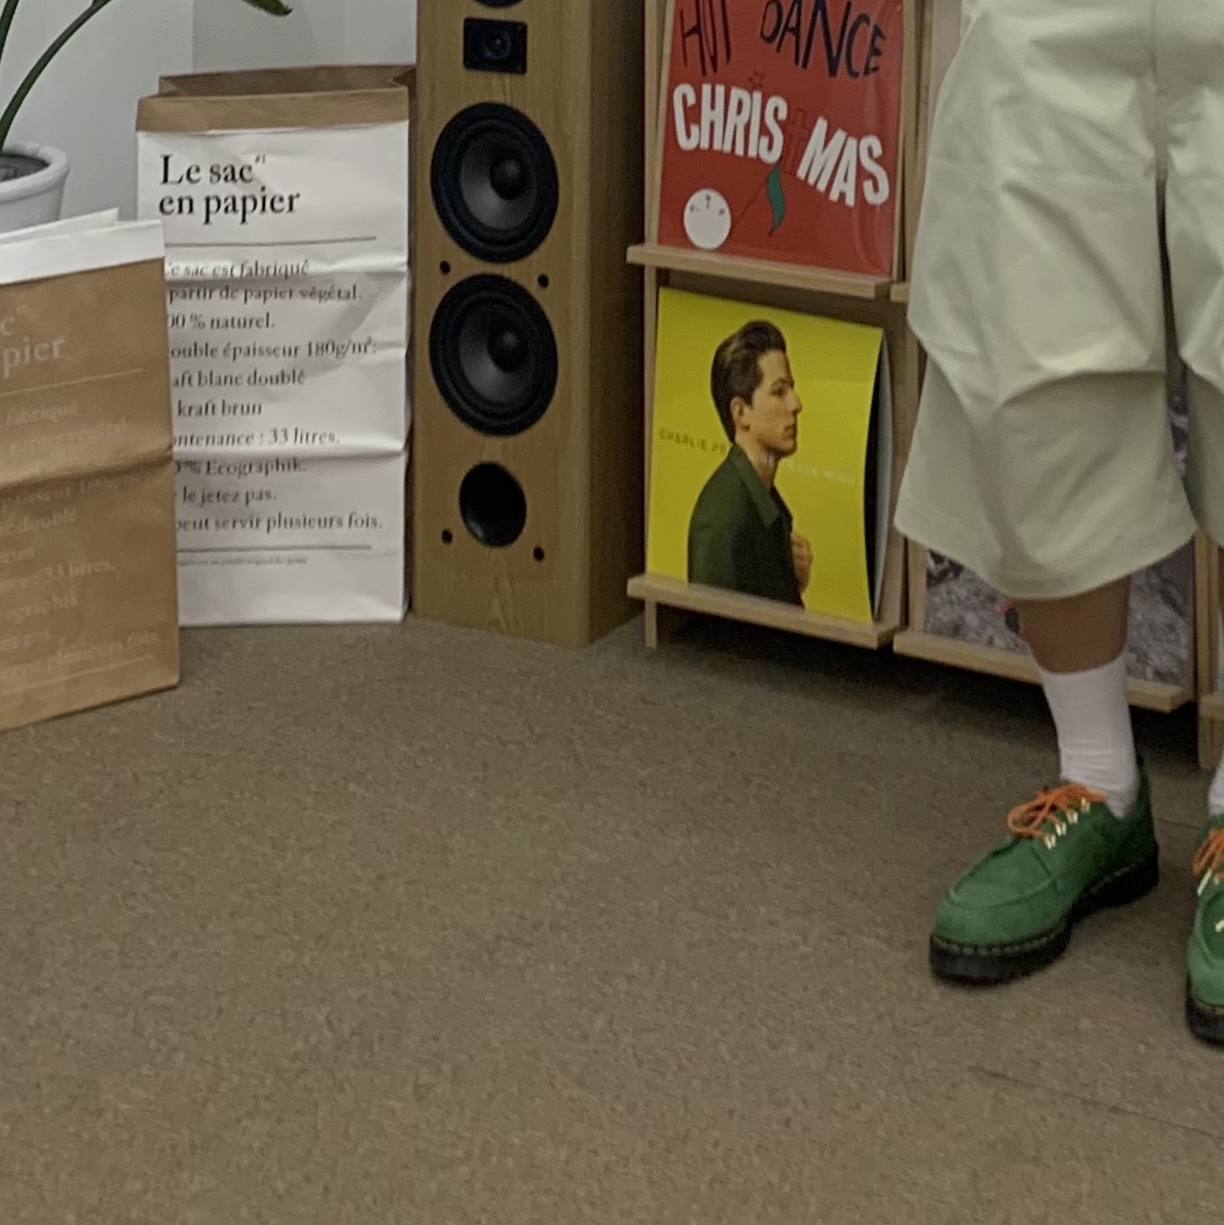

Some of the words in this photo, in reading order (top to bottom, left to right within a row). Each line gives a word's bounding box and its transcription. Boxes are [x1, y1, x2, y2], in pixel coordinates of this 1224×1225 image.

[673, 83, 788, 164] CHRIS
[796, 116, 890, 207] MAS
[160, 154, 201, 185] Le
[209, 162, 253, 184] sac
[158, 195, 194, 215] en
[203, 186, 301, 225] papier
[184, 265, 208, 276] sac
[212, 262, 236, 276] est
[239, 258, 310, 280] fabriqué
[169, 286, 214, 305] partir
[219, 285, 237, 300] de
[243, 286, 295, 305] papier
[299, 283, 362, 303] végétal.
[210, 312, 275, 329] naturel.
[2, 336, 66, 380] pier
[170, 341, 219, 358] ouble
[223, 343, 300, 362] épaisseur
[172, 371, 193, 387] aft
[197, 370, 244, 387] blanc
[247, 369, 305, 386] doublé
[177, 399, 216, 417] kraft
[221, 399, 262, 416] brun
[172, 431, 254, 447] ontenance
[269, 428, 288, 445] 33
[293, 427, 340, 444] litres.
[182, 486, 195, 502] le
[199, 488, 239, 506] jetez
[245, 489, 277, 506] pas.
[214, 516, 260, 531] servir
[266, 512, 343, 534] plusieurs
[347, 512, 383, 531] fois.
